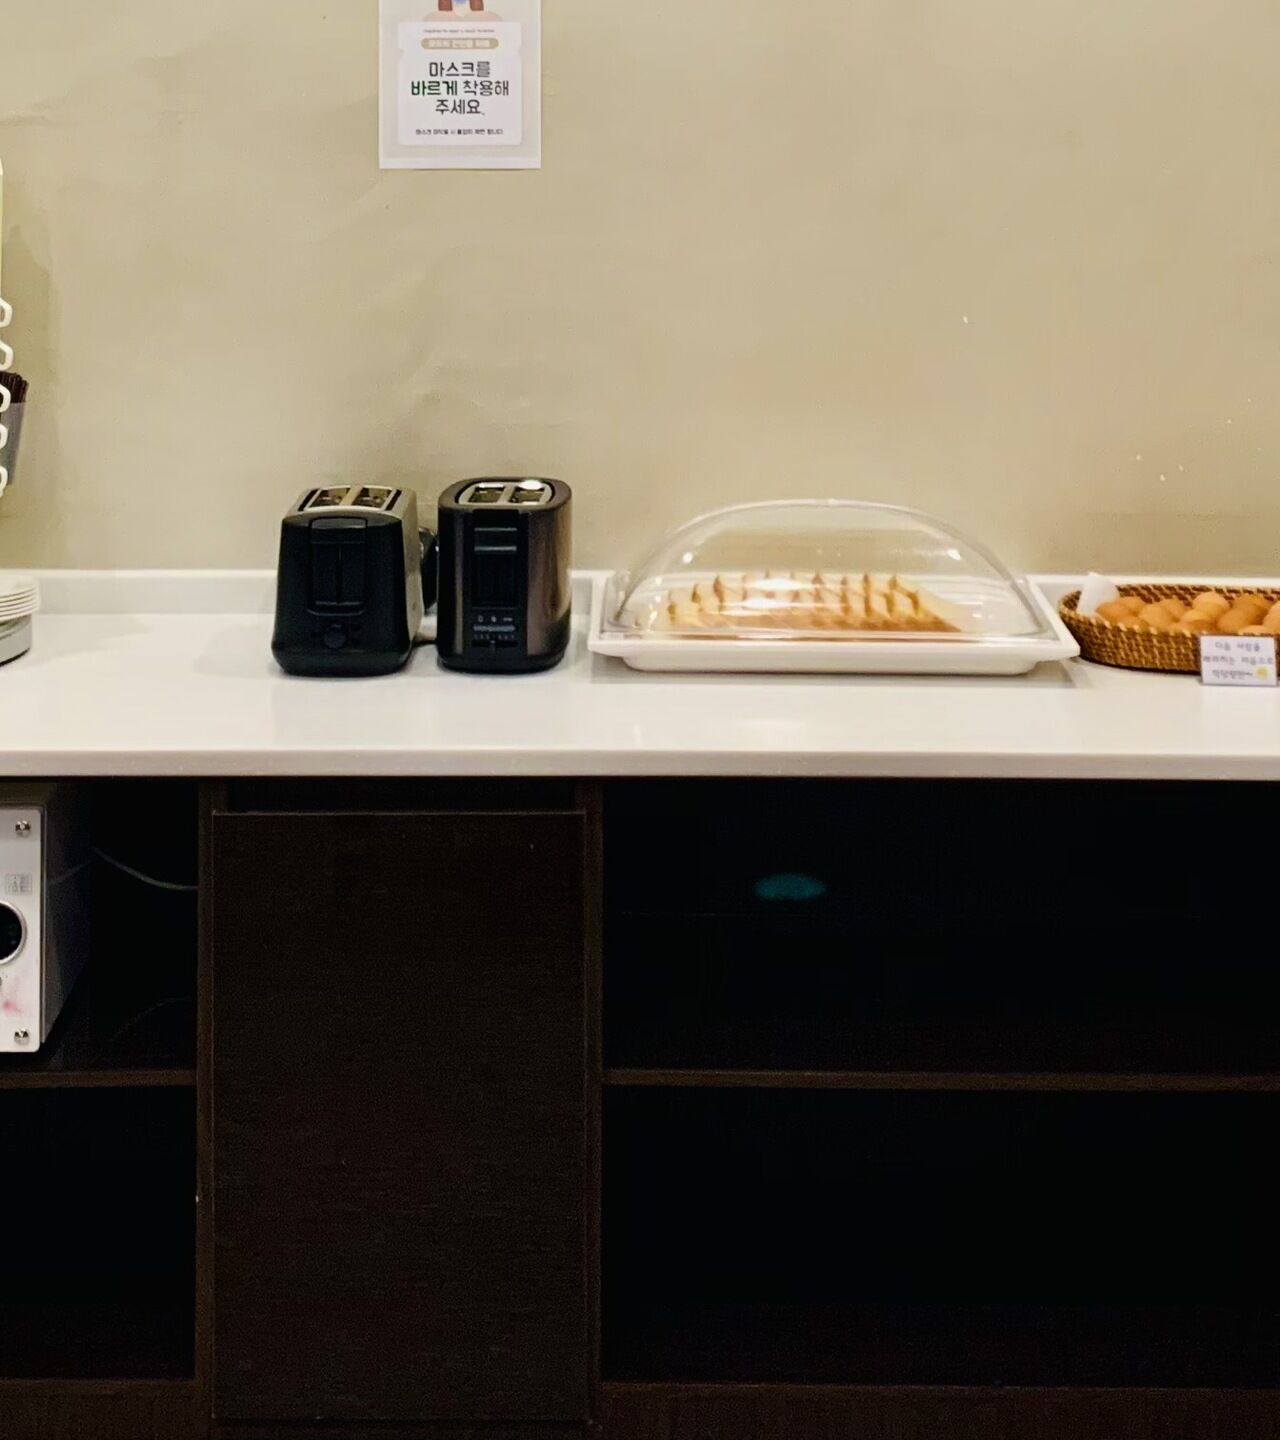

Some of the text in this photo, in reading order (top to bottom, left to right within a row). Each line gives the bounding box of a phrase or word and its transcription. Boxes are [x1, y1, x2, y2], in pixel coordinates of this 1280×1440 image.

[429, 61, 490, 78] 마스크를
[411, 80, 509, 96] 바르게 착용해
